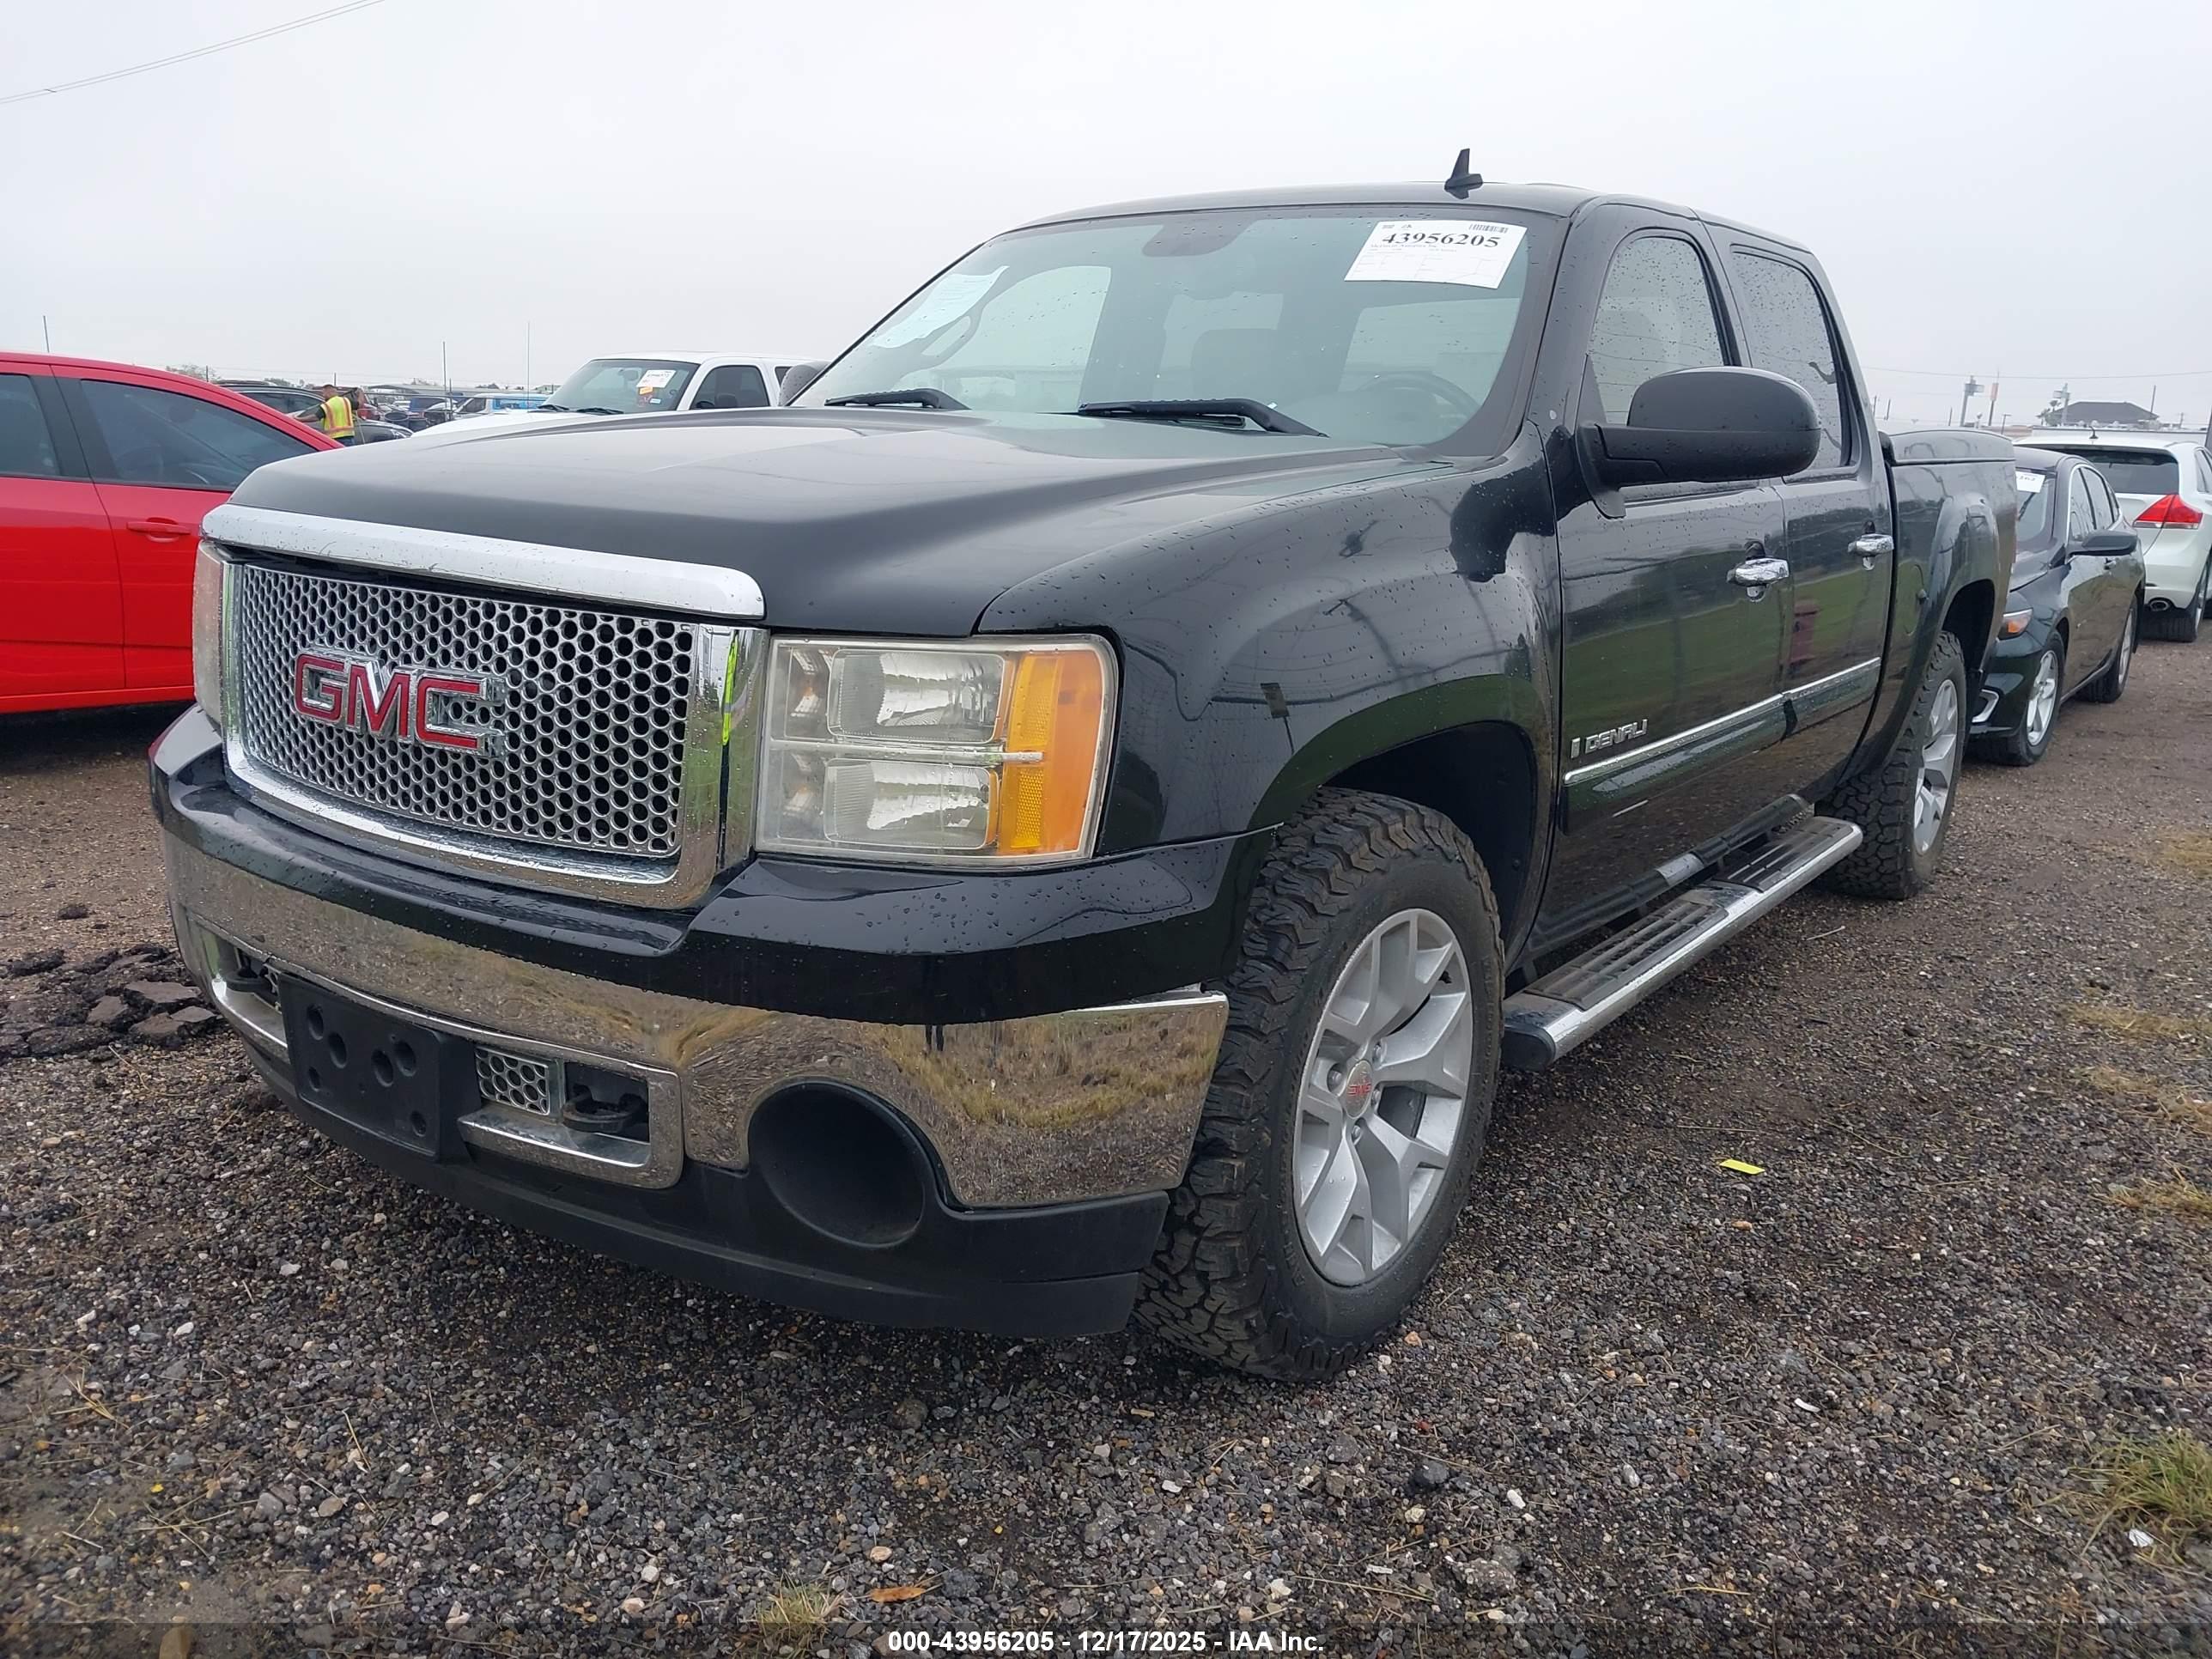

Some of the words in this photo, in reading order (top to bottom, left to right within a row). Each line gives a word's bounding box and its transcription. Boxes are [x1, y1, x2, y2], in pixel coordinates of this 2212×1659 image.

[1381, 232, 1501, 248] 43956205
[294, 649, 488, 756] GMC
[1584, 718, 1649, 754] DENALI
